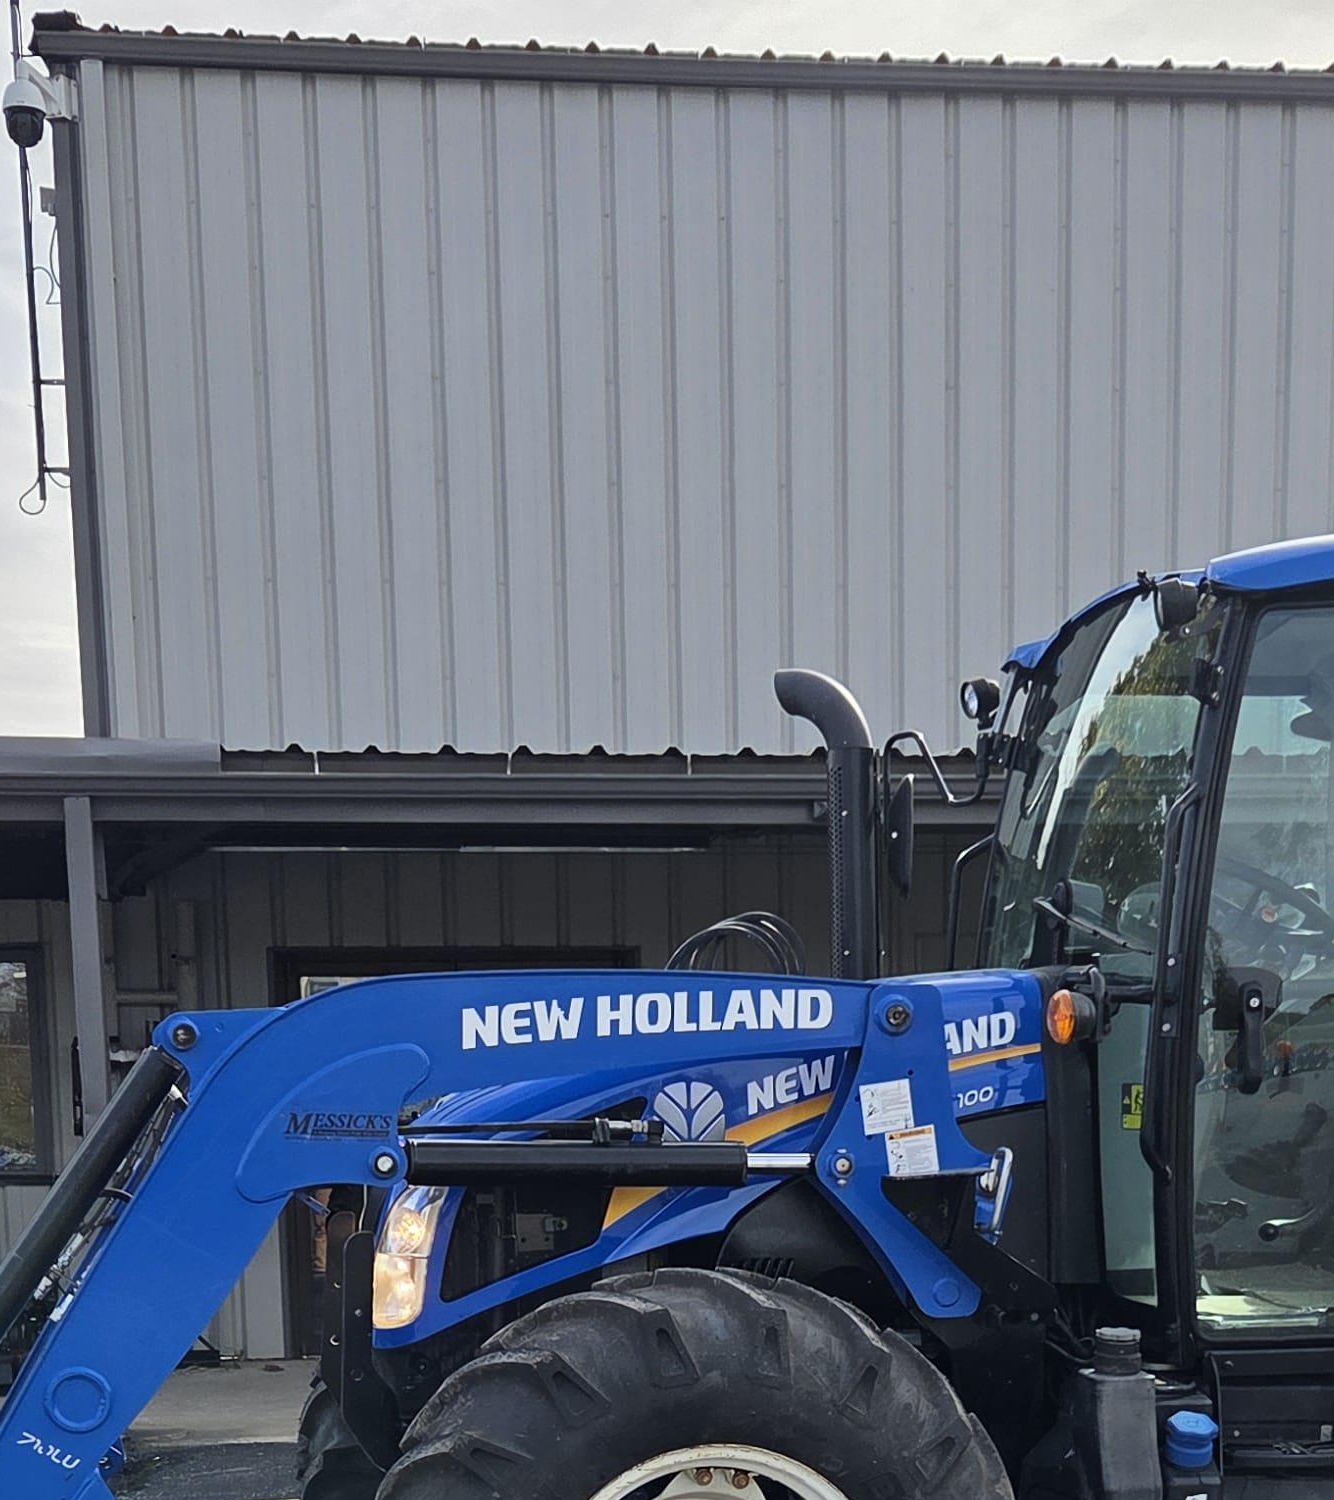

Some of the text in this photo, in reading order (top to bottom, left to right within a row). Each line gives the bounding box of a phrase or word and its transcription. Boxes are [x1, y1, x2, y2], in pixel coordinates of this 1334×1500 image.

[462, 989, 833, 1050] NEW HOLLAND
[746, 1055, 835, 1115] NEW
[284, 1112, 392, 1136] MESSICK'S
